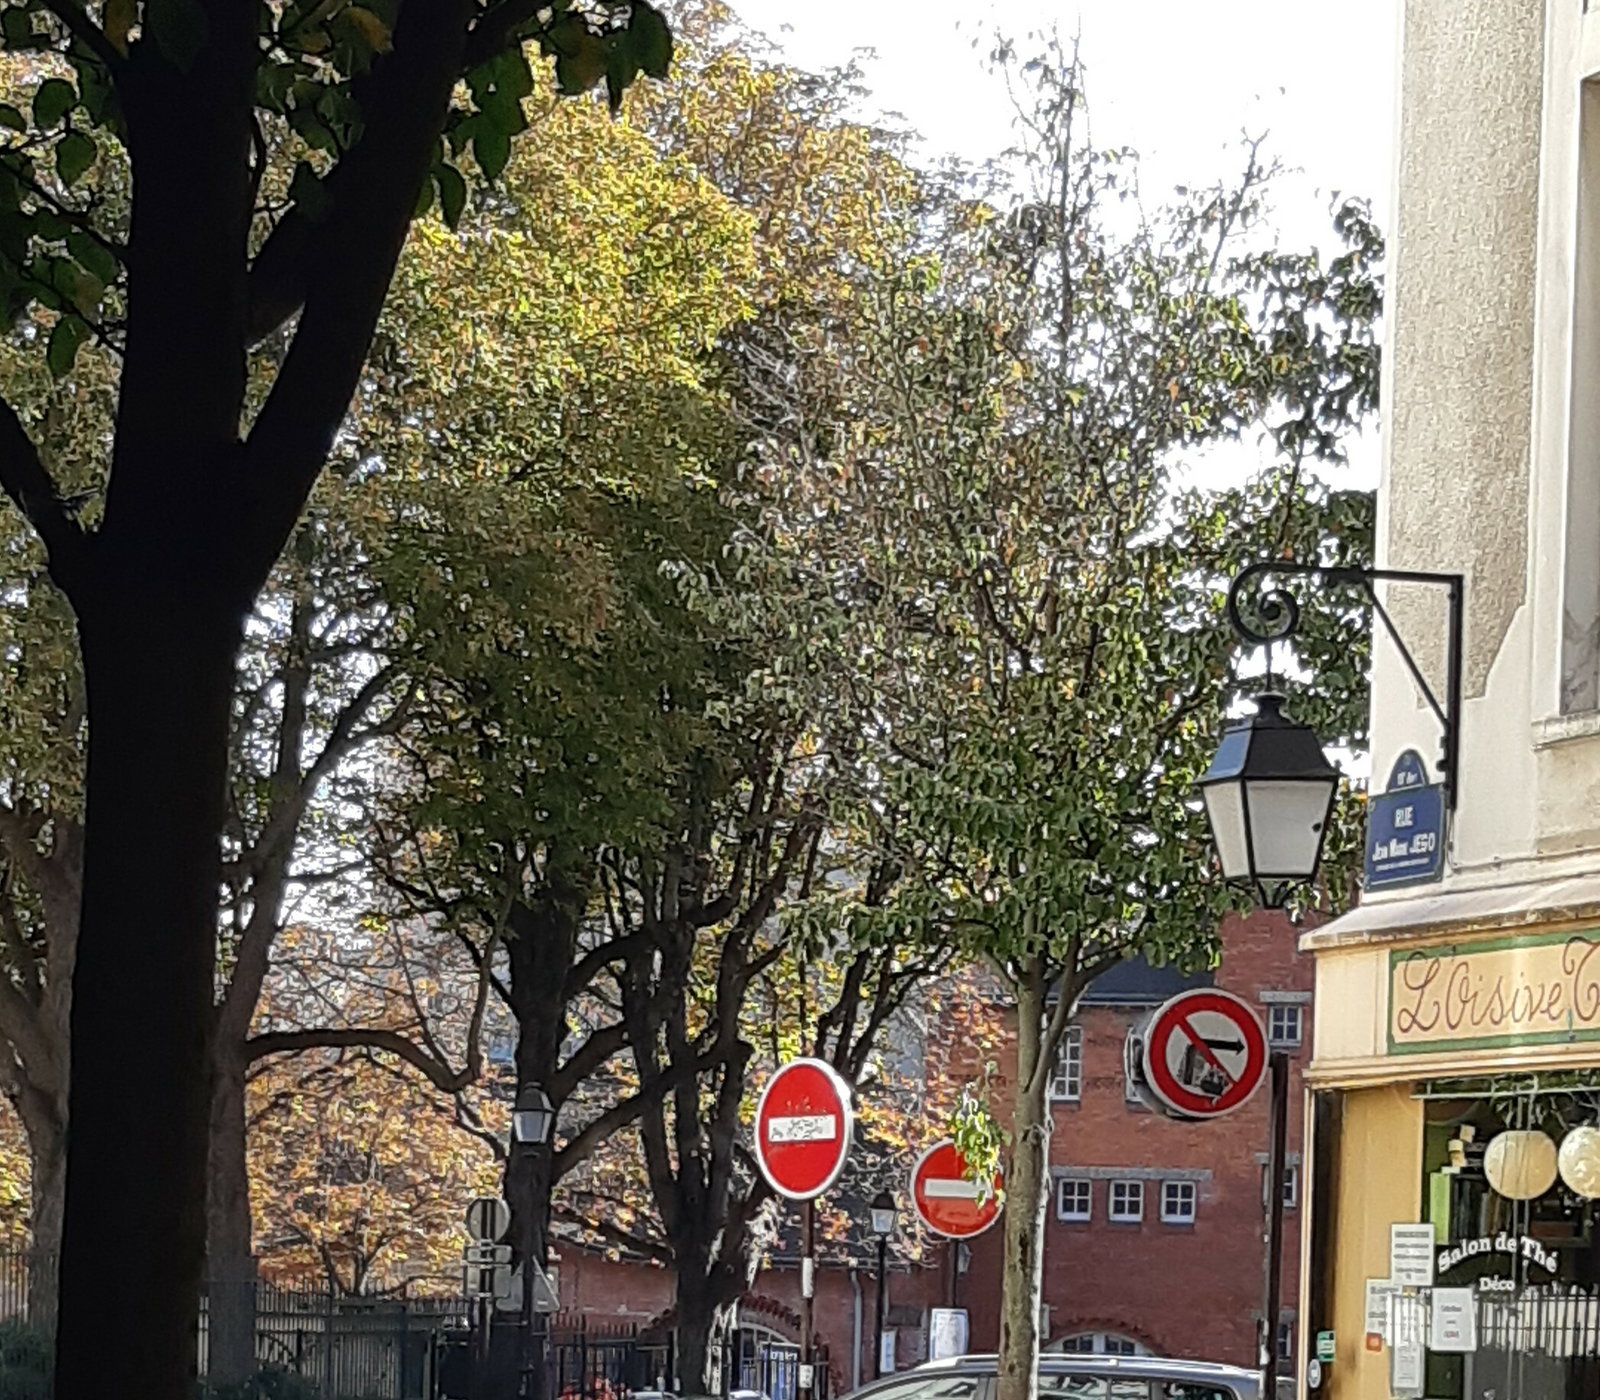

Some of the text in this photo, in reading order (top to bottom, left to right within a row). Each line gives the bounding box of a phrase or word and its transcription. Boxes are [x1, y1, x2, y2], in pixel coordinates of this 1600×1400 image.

[1394, 805, 1415, 828] RUE
[1437, 1231, 1559, 1274] Salon de Thé
[1479, 1273, 1515, 1291] Déco
